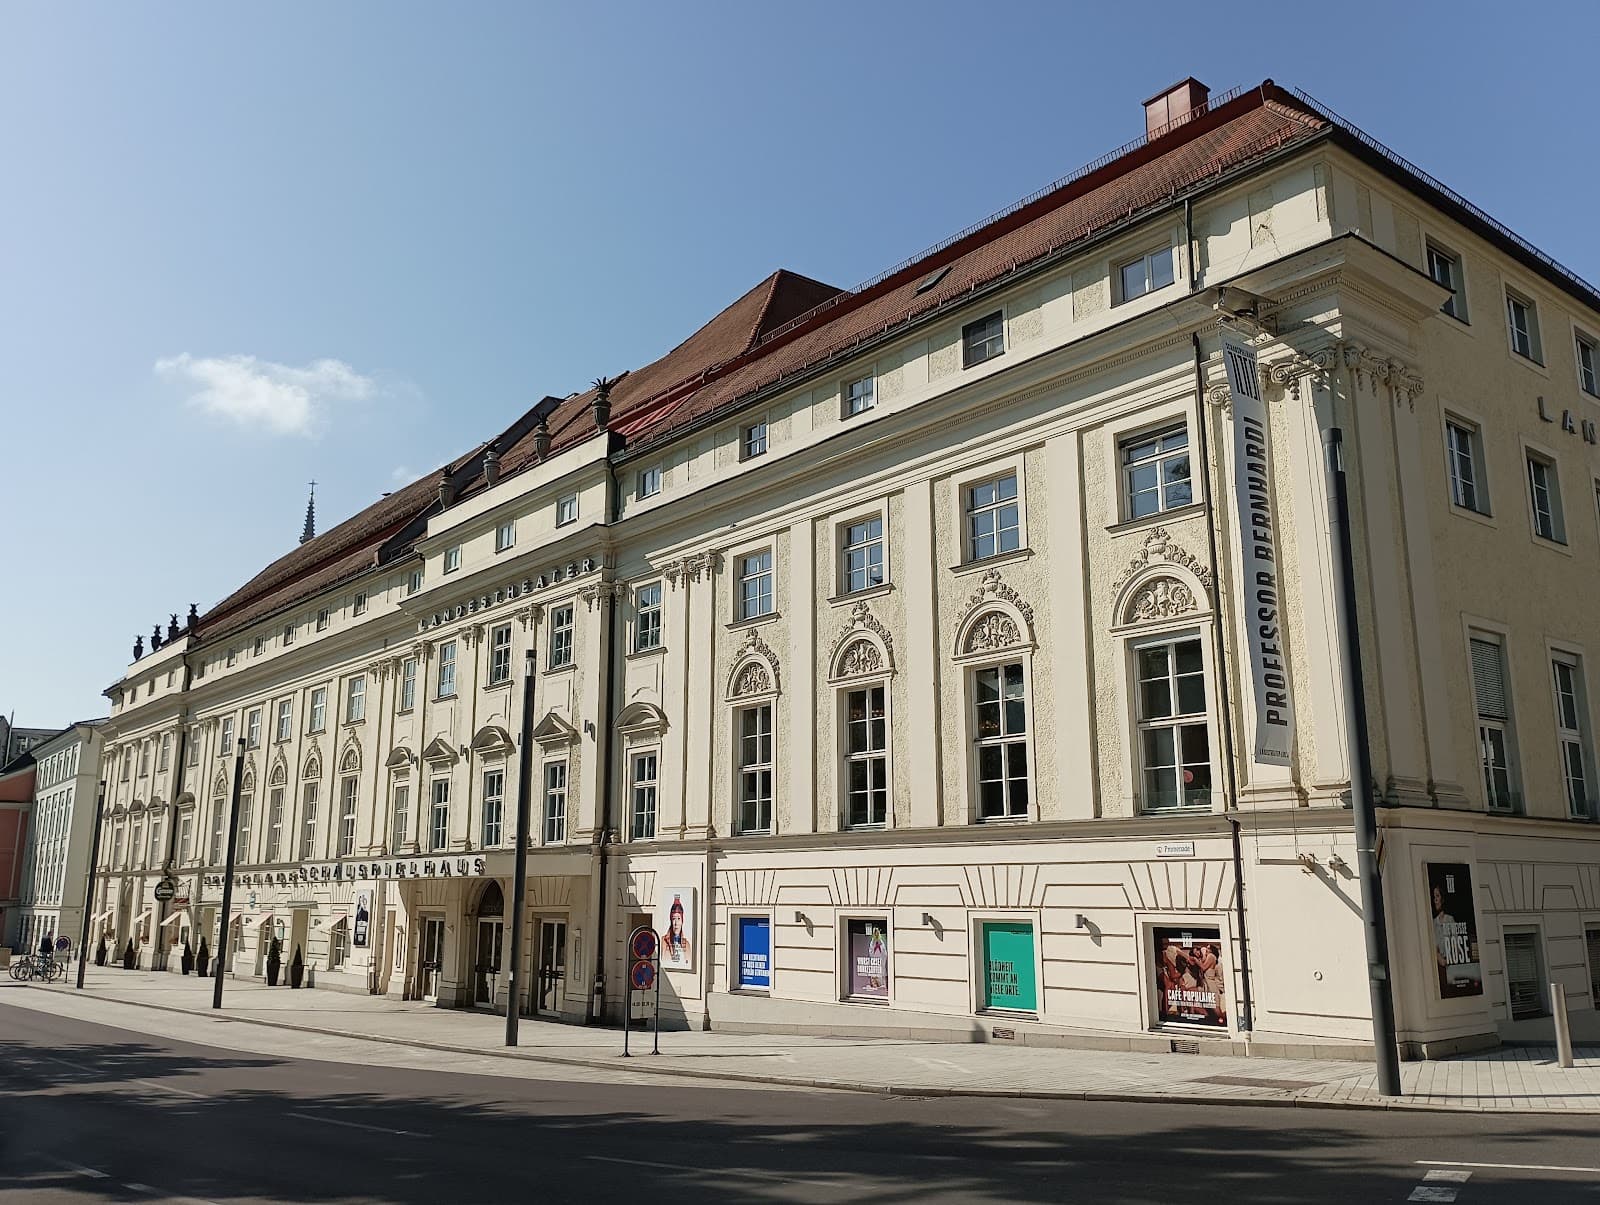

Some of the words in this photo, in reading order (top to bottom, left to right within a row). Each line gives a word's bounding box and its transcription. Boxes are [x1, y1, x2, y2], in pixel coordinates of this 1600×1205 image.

[1243, 416, 1275, 560] BERNHARDI
[417, 558, 594, 632] LANDESTHEATER
[1256, 571, 1288, 727] PROFESSOR
[1445, 935, 1471, 965] ROSE
